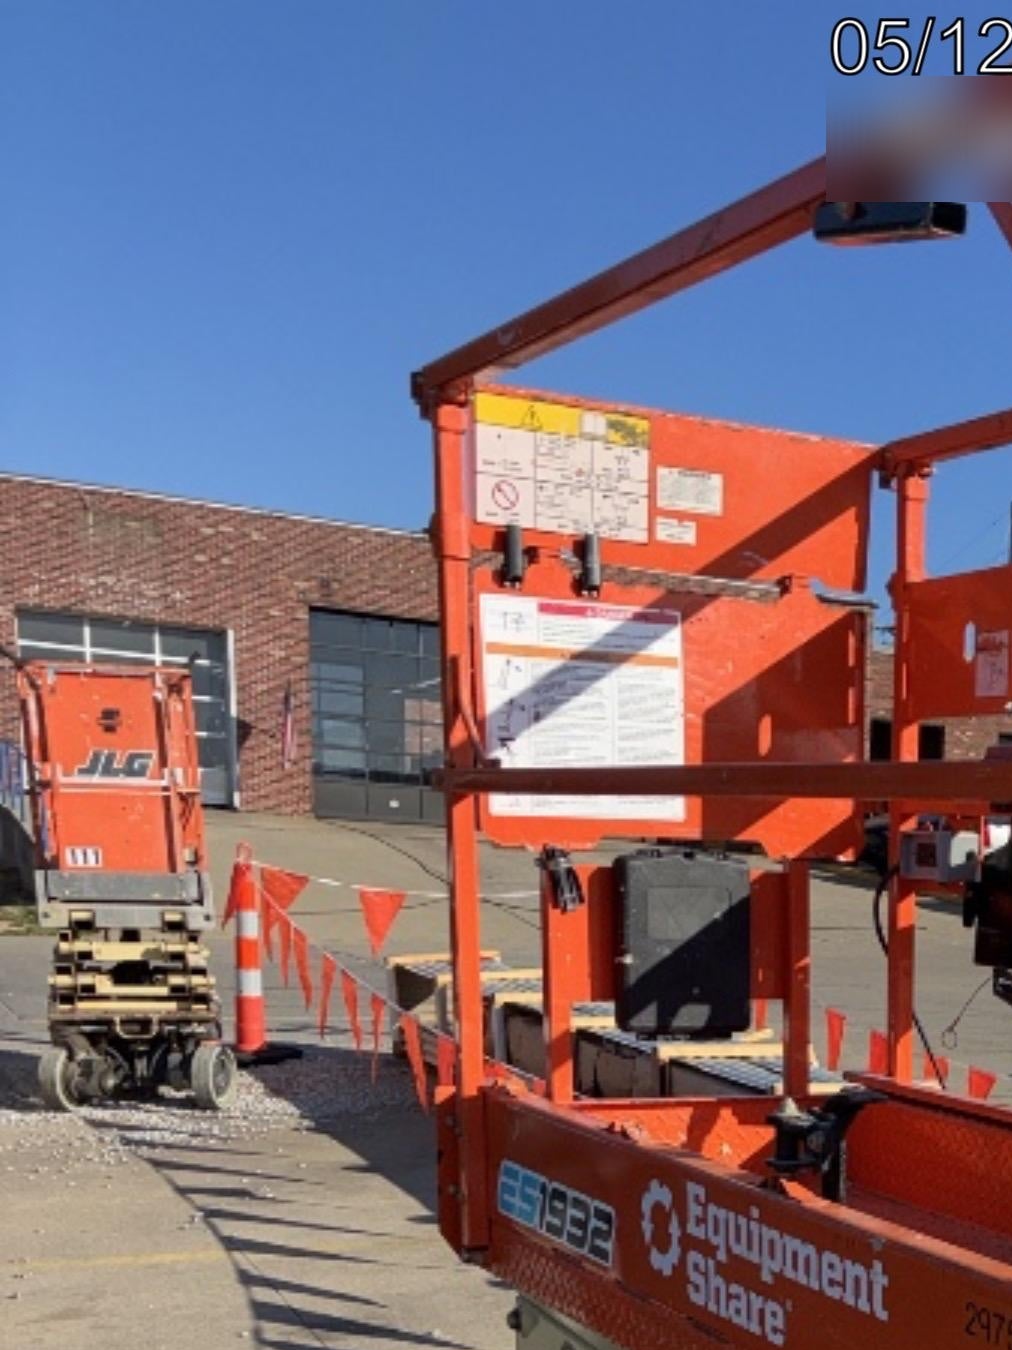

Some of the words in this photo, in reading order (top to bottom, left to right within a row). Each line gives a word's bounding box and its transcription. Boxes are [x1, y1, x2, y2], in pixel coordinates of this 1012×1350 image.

[75, 749, 156, 781] JLG
[500, 1161, 616, 1267] ES1932
[686, 1181, 889, 1322] Equipment
[686, 1250, 785, 1347] Share
